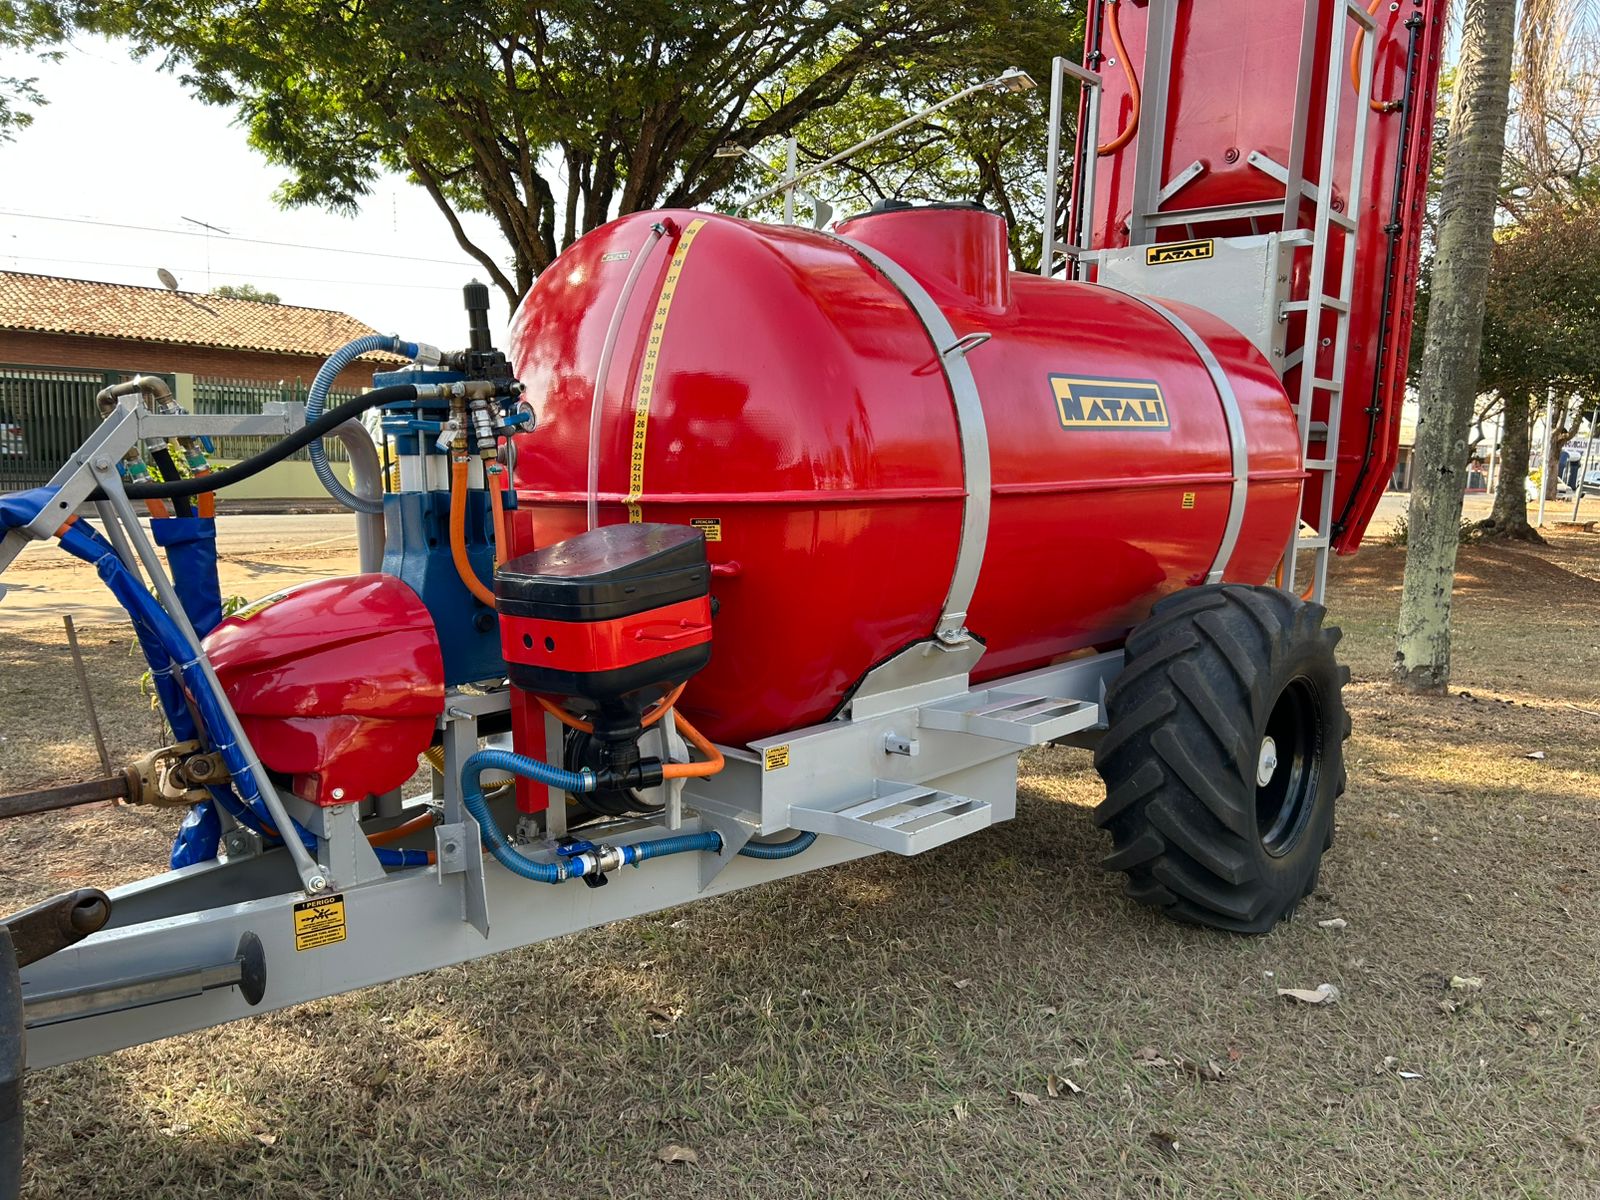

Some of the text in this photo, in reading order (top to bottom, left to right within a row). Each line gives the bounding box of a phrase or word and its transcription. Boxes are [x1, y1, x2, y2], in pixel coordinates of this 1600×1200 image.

[1149, 243, 1210, 262] NATALI
[1060, 384, 1165, 421] NATALI
[306, 898, 335, 908] PERIGO
